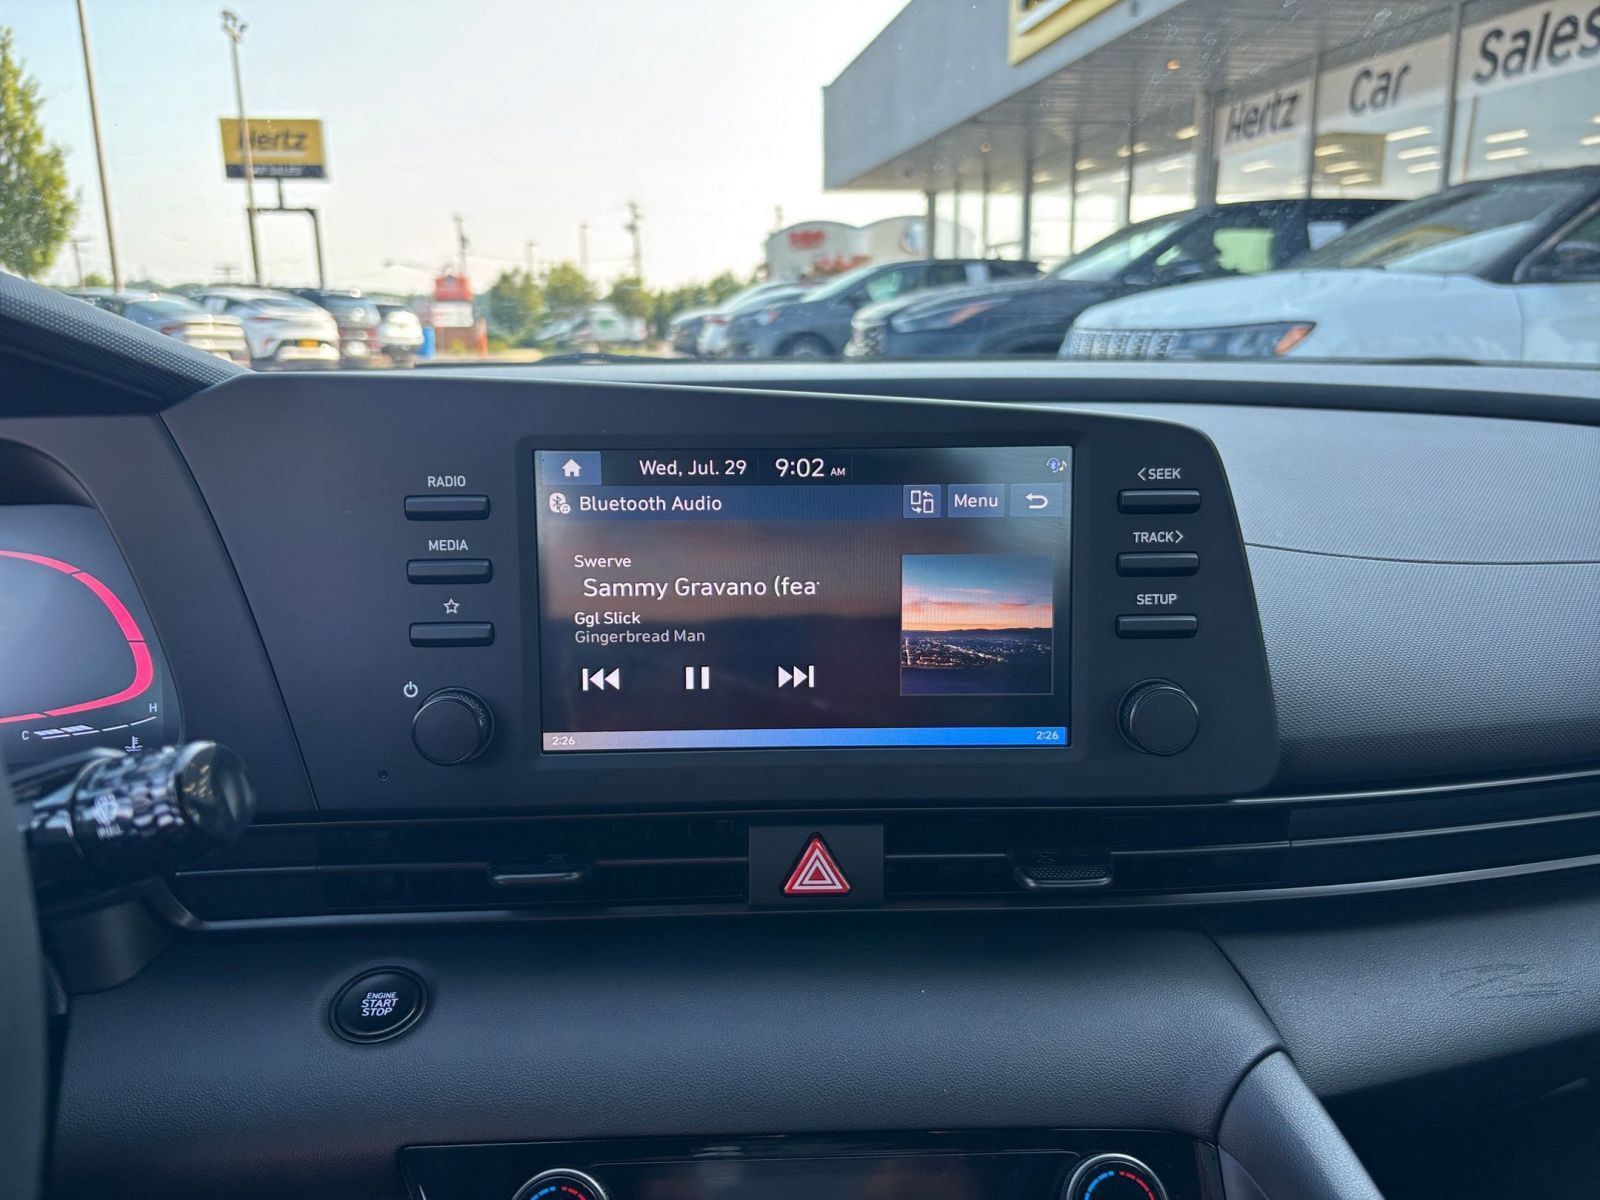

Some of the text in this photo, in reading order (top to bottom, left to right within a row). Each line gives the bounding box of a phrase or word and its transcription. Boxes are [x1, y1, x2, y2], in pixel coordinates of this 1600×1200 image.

[1349, 62, 1410, 117] Car
[1226, 90, 1301, 144] Hertz
[639, 459, 747, 478] Wed, Jul. 29
[775, 458, 846, 477] 9:02 AM
[427, 475, 466, 487] RADIO
[579, 496, 722, 512] Bluetooth Audio
[954, 494, 998, 509] Menu
[428, 539, 468, 551] MEDIA
[574, 555, 632, 568] Swerve
[583, 575, 821, 600] Sammy Gravano (fea
[1136, 593, 1177, 605] SETUP
[574, 611, 641, 627] Ggl Slick
[575, 629, 706, 645] Gingerbread Man
[149, 703, 157, 712] H
[21, 730, 29, 740] C
[552, 735, 575, 746] 2:26
[1036, 730, 1059, 741] 2:26
[366, 991, 398, 999] ENGINE
[361, 998, 399, 1008] START
[361, 1007, 393, 1017] STOP
